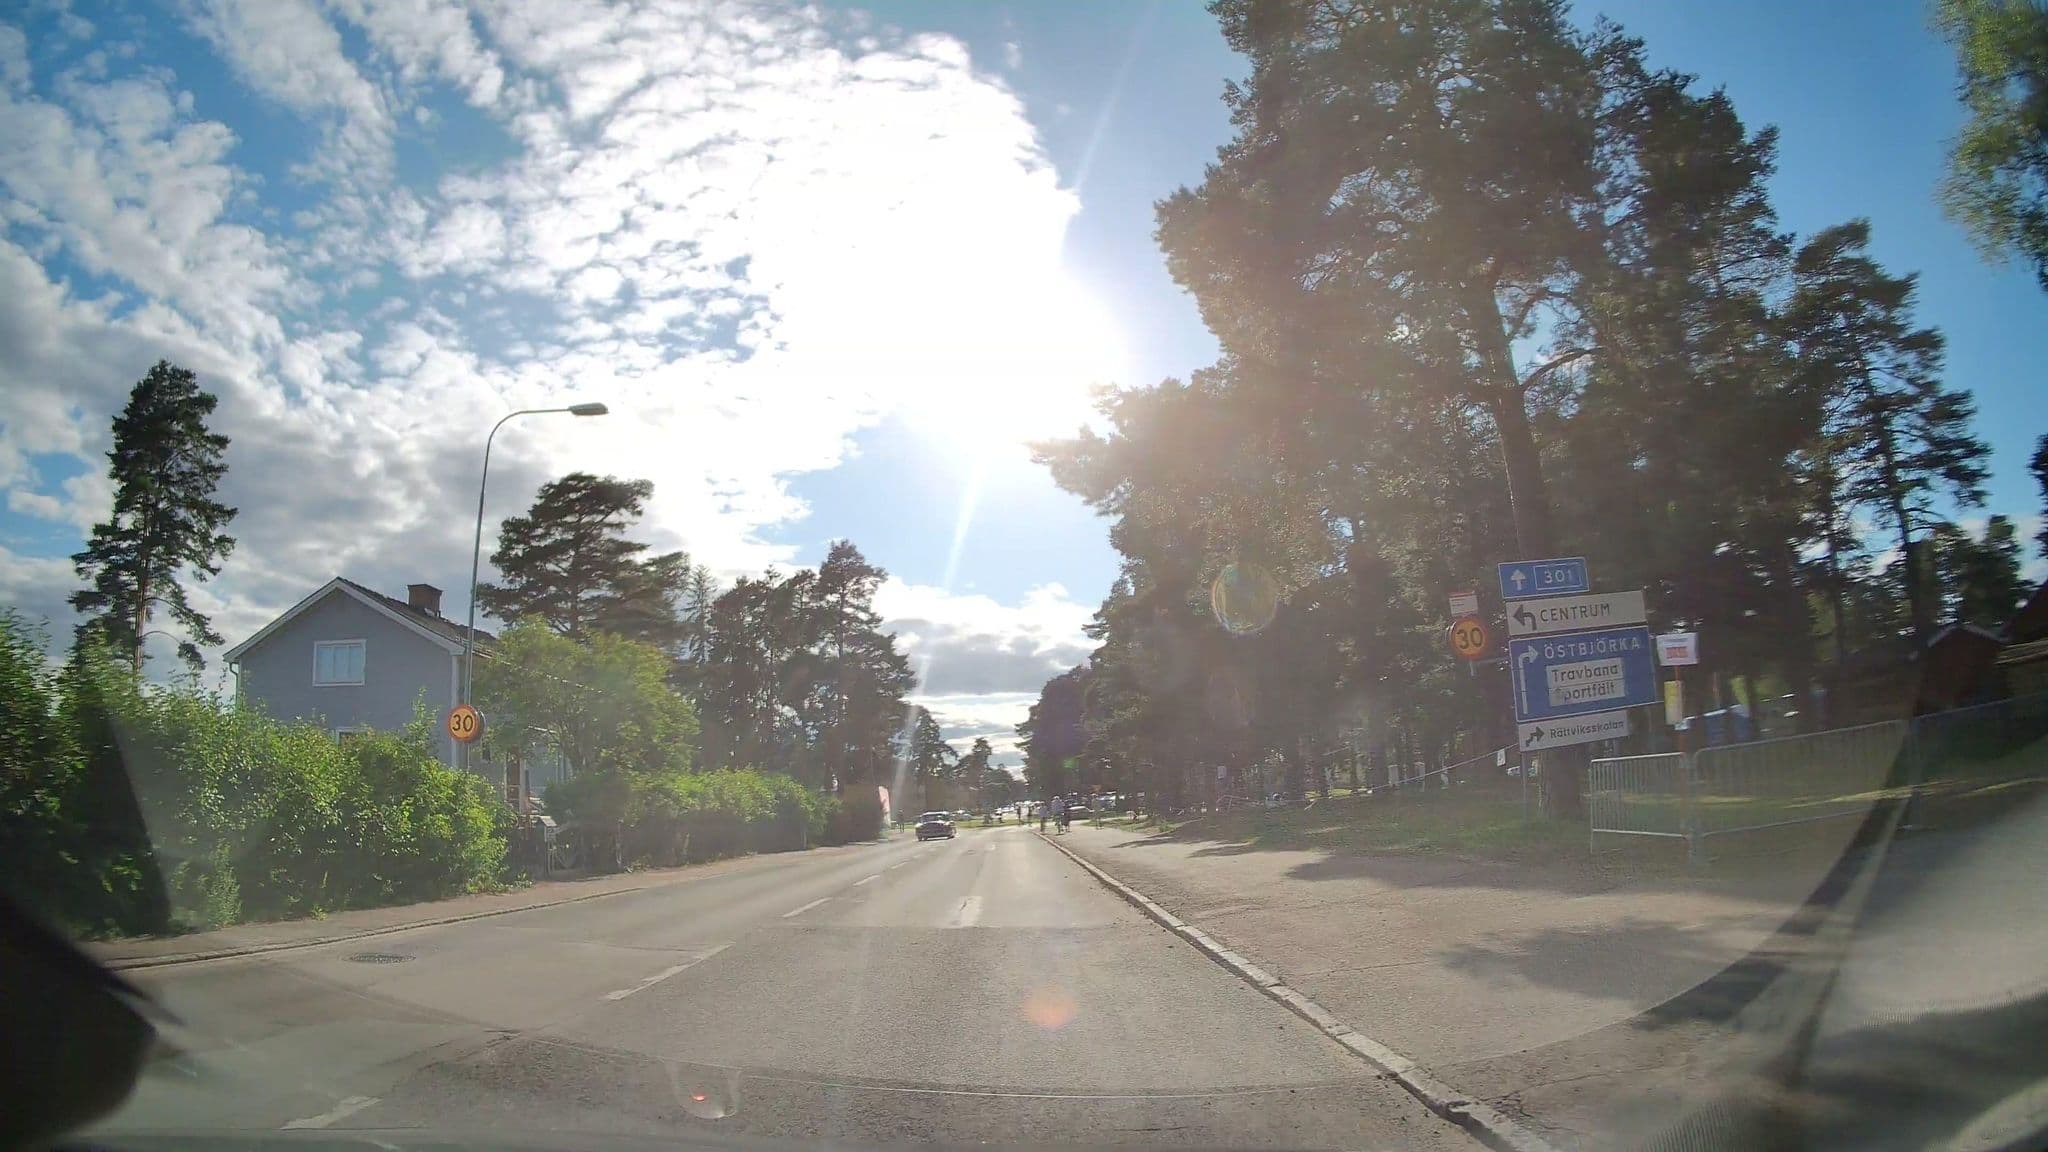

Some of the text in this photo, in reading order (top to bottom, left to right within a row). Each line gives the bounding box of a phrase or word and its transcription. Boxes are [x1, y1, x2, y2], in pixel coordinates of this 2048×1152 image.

[1543, 567, 1574, 584] 301
[1539, 603, 1611, 623] CENTRUM
[1456, 626, 1483, 649] 30
[1543, 637, 1641, 659] ÖSTBJÖRKA
[1551, 664, 1619, 683] Travbana
[452, 714, 474, 732] 30
[1549, 720, 1625, 739] Rättviksskolan
